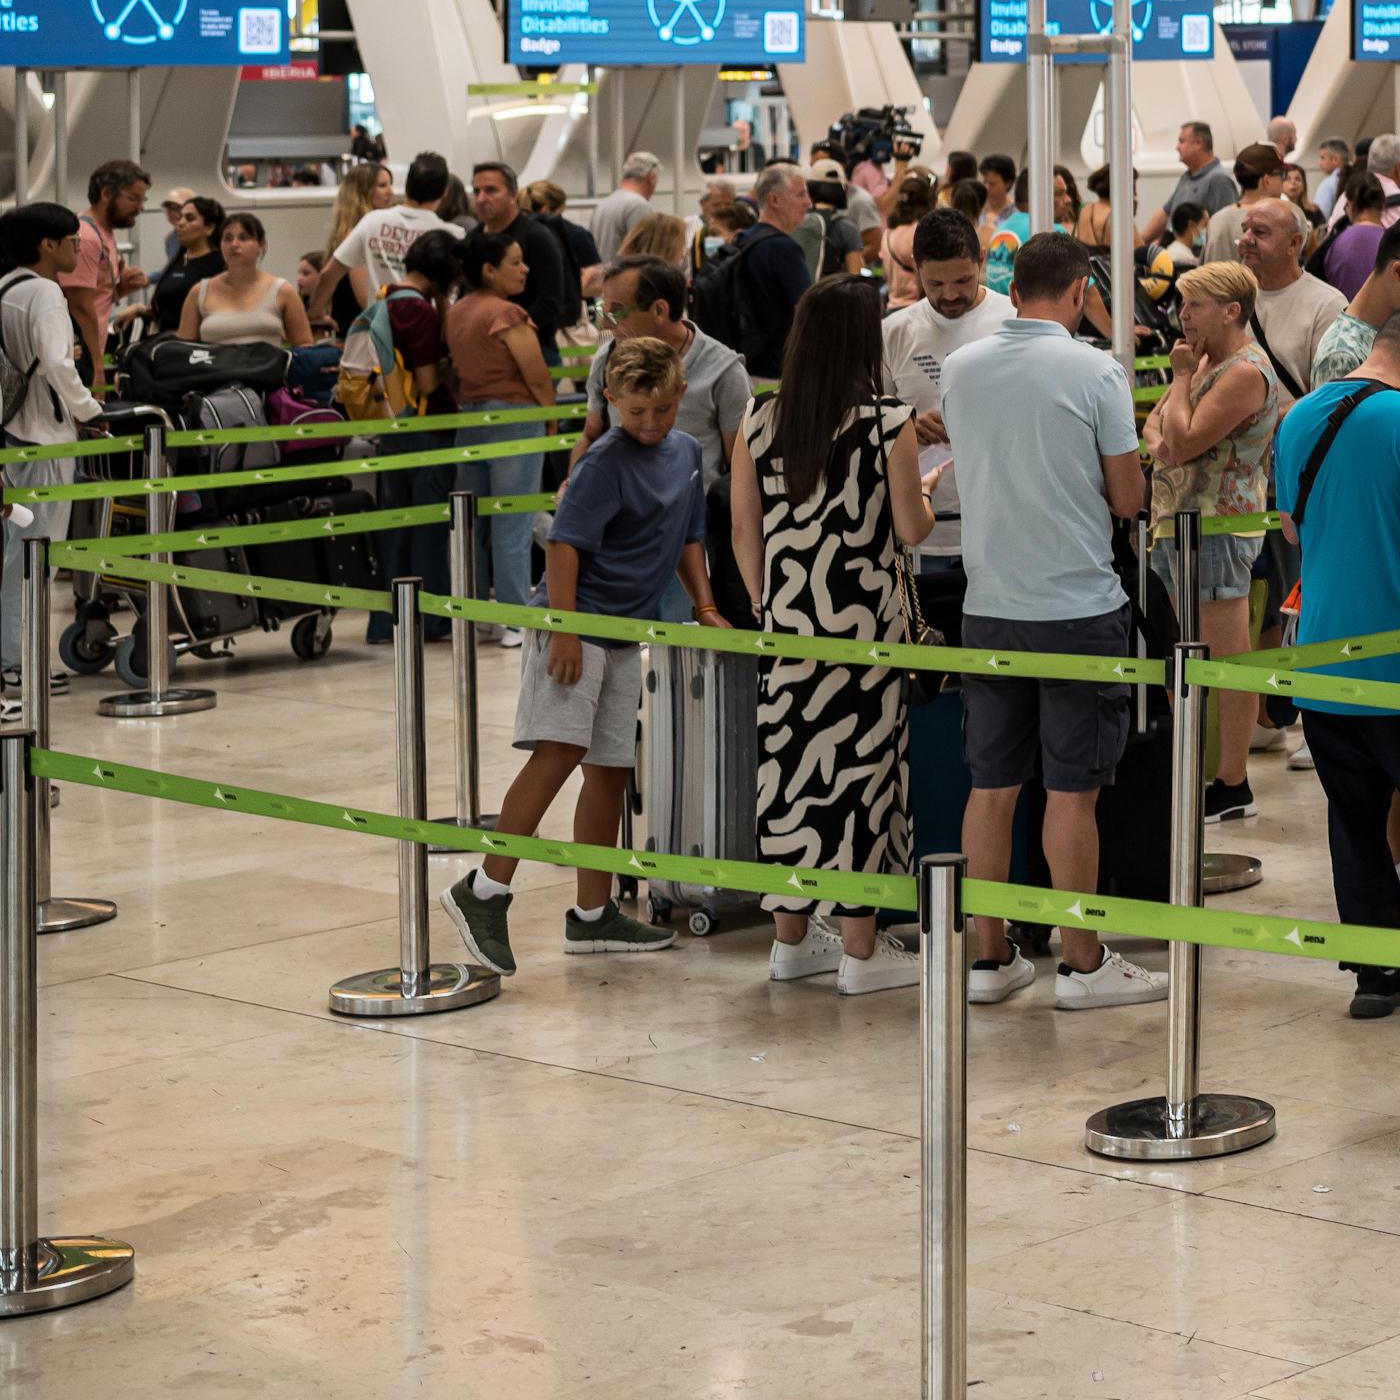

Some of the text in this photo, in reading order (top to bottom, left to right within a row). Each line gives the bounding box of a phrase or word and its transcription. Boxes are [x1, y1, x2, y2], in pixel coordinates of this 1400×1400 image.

[521, 16, 609, 34] Disabilities
[521, 37, 561, 55] Badge
[991, 38, 1023, 55] Badge
[262, 67, 316, 79] IBERIA
[801, 879, 818, 887] aena
[1085, 908, 1106, 917] aena
[1303, 935, 1325, 945] aena
